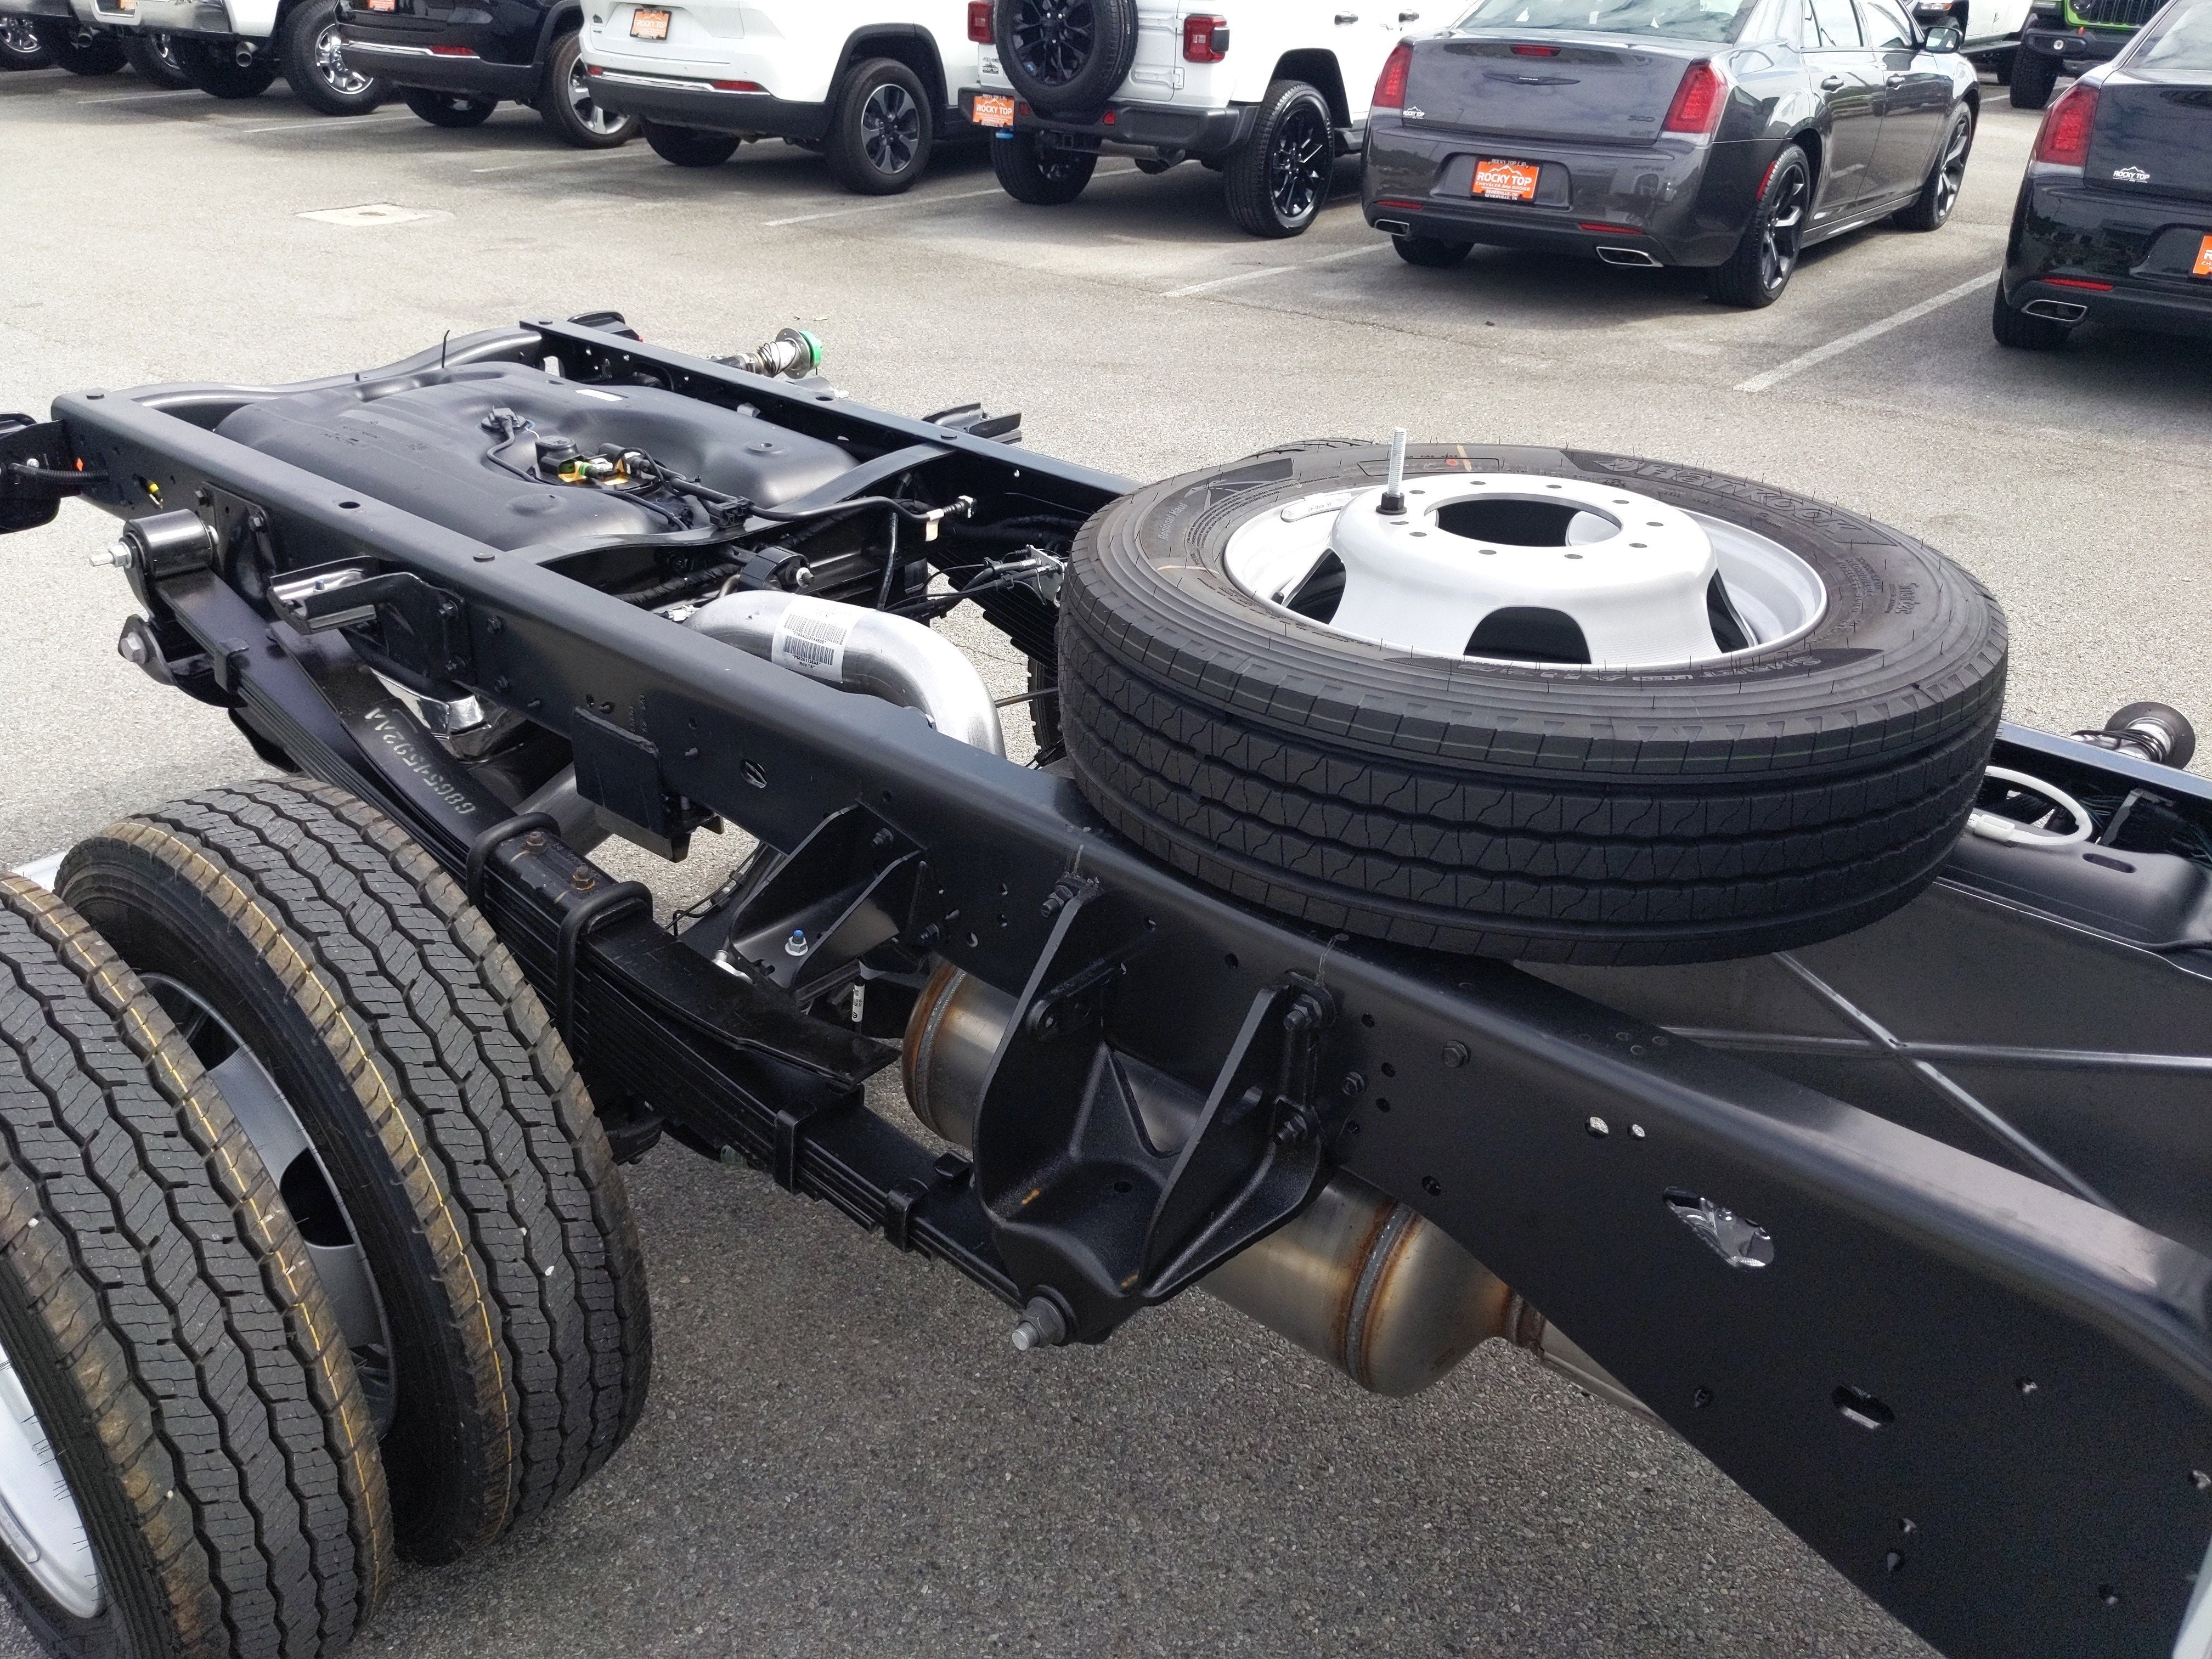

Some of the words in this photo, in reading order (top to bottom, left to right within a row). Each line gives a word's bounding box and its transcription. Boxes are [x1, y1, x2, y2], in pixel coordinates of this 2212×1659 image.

[977, 104, 998, 114] ROCKY
[999, 107, 1012, 115] TOP
[1477, 172, 1510, 184] ROCKY
[1511, 176, 1532, 186] TOP
[1158, 512, 1179, 541] Regional
